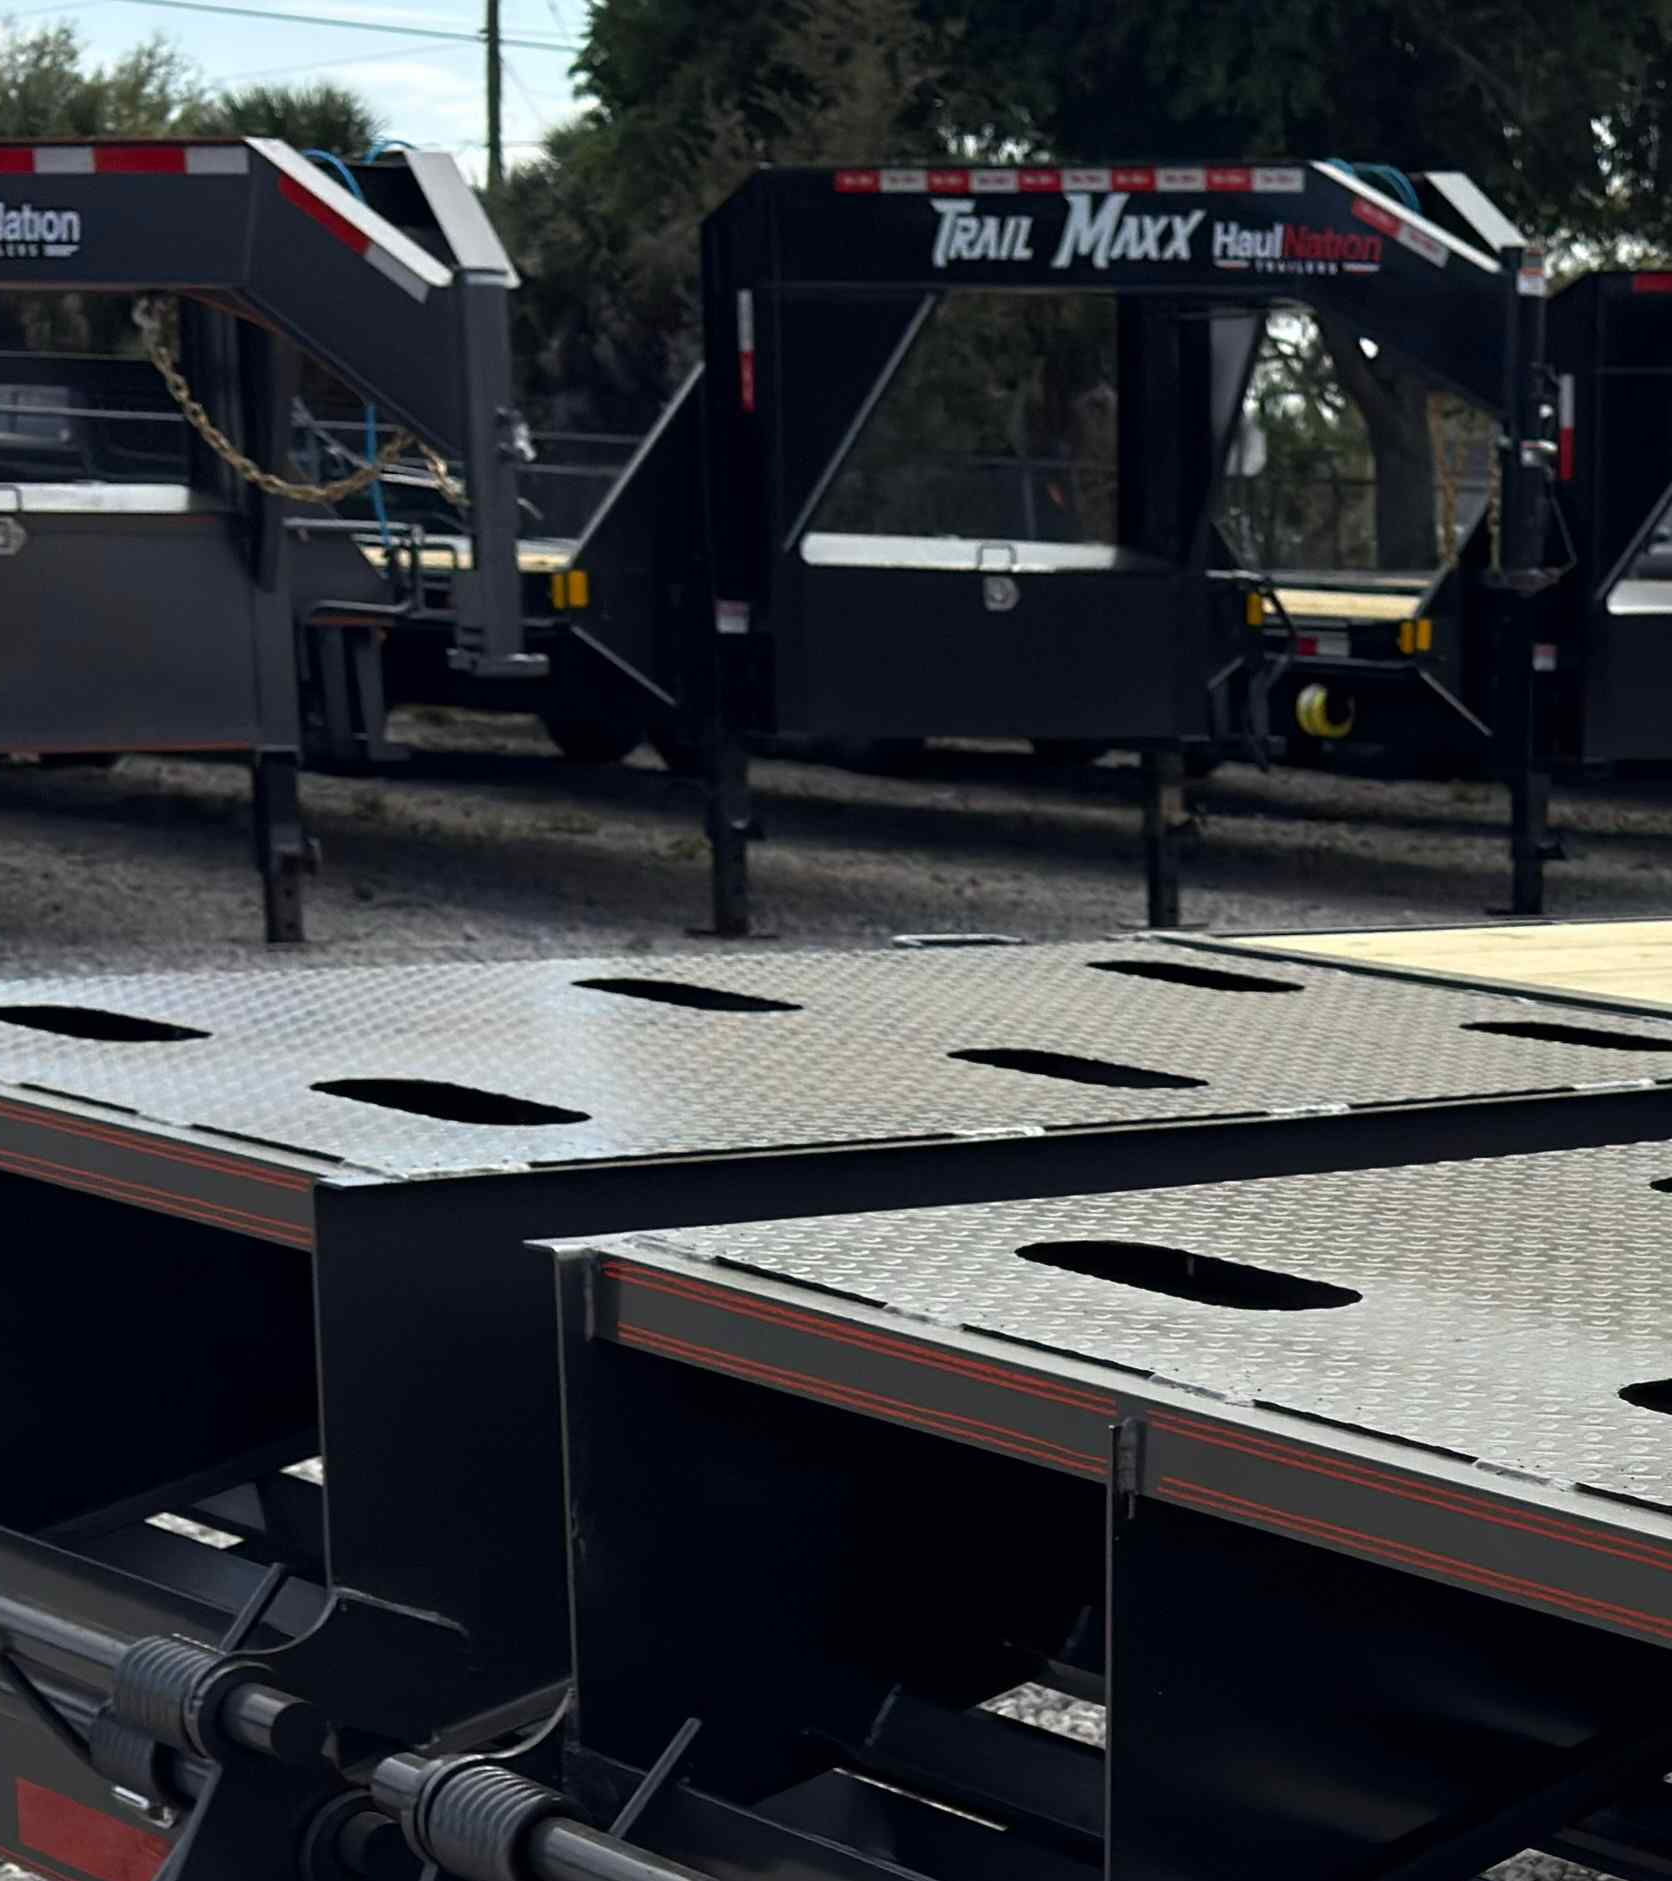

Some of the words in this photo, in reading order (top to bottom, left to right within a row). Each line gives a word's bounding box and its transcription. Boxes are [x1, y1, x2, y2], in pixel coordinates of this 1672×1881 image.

[930, 199, 1033, 268] TRAIL
[1051, 191, 1206, 269] MAXX
[1212, 221, 1383, 262] HaulNation
